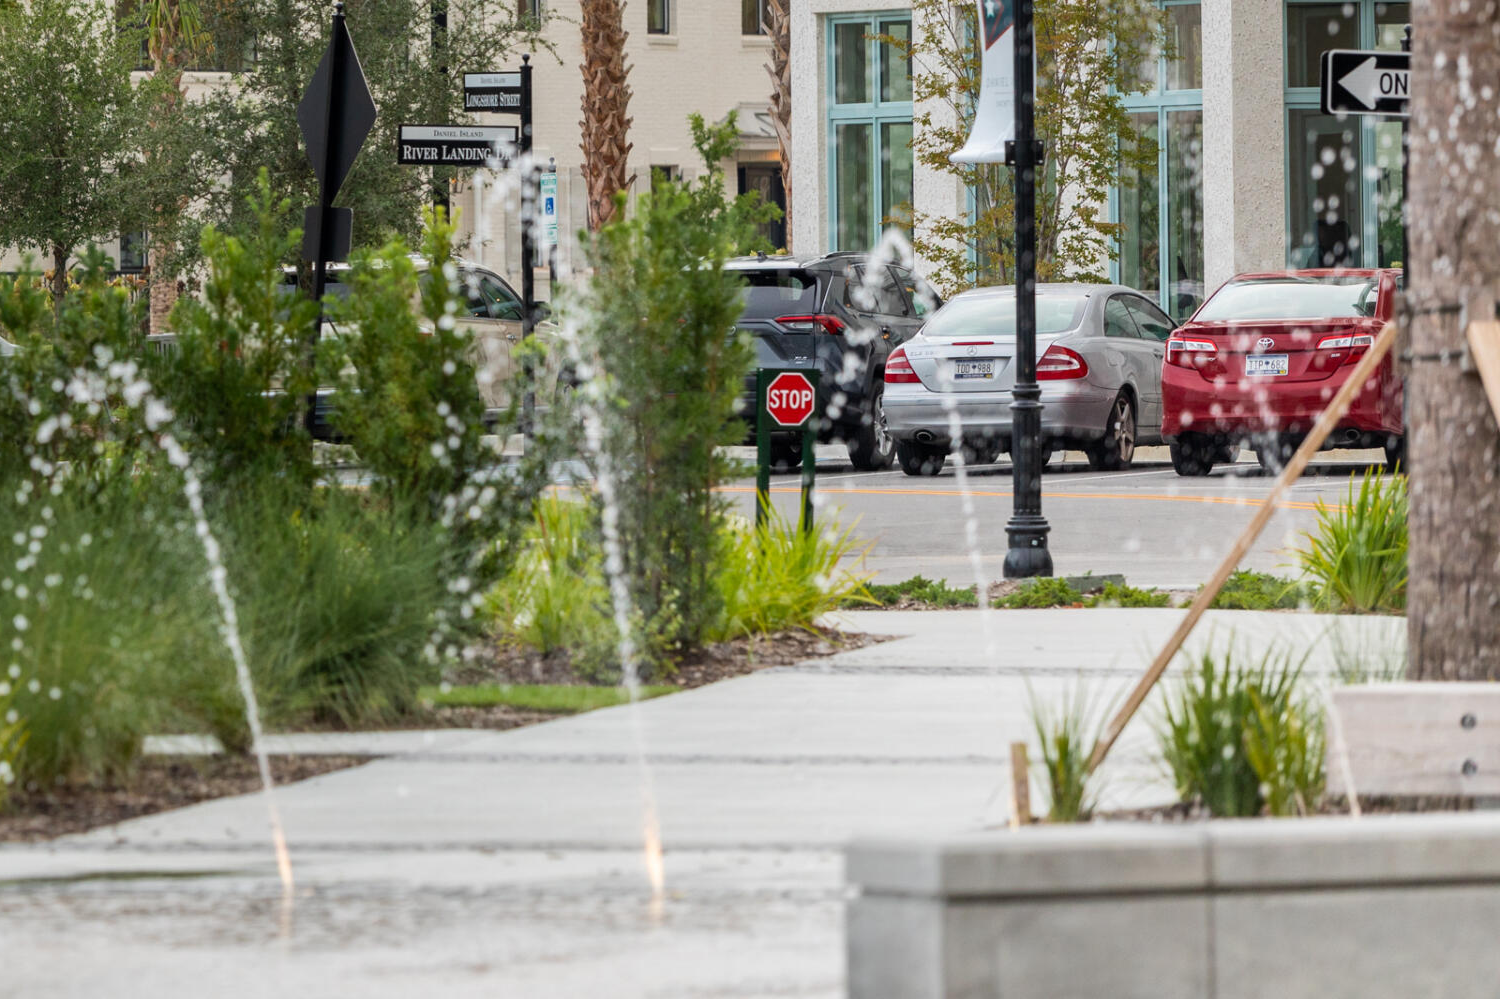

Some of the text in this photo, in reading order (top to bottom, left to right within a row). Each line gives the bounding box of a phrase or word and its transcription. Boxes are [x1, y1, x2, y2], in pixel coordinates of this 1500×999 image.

[465, 91, 521, 108] LONGSHORE STREET
[402, 145, 438, 160] RIVER
[441, 145, 491, 161] LANDING
[769, 389, 812, 409] STOP
